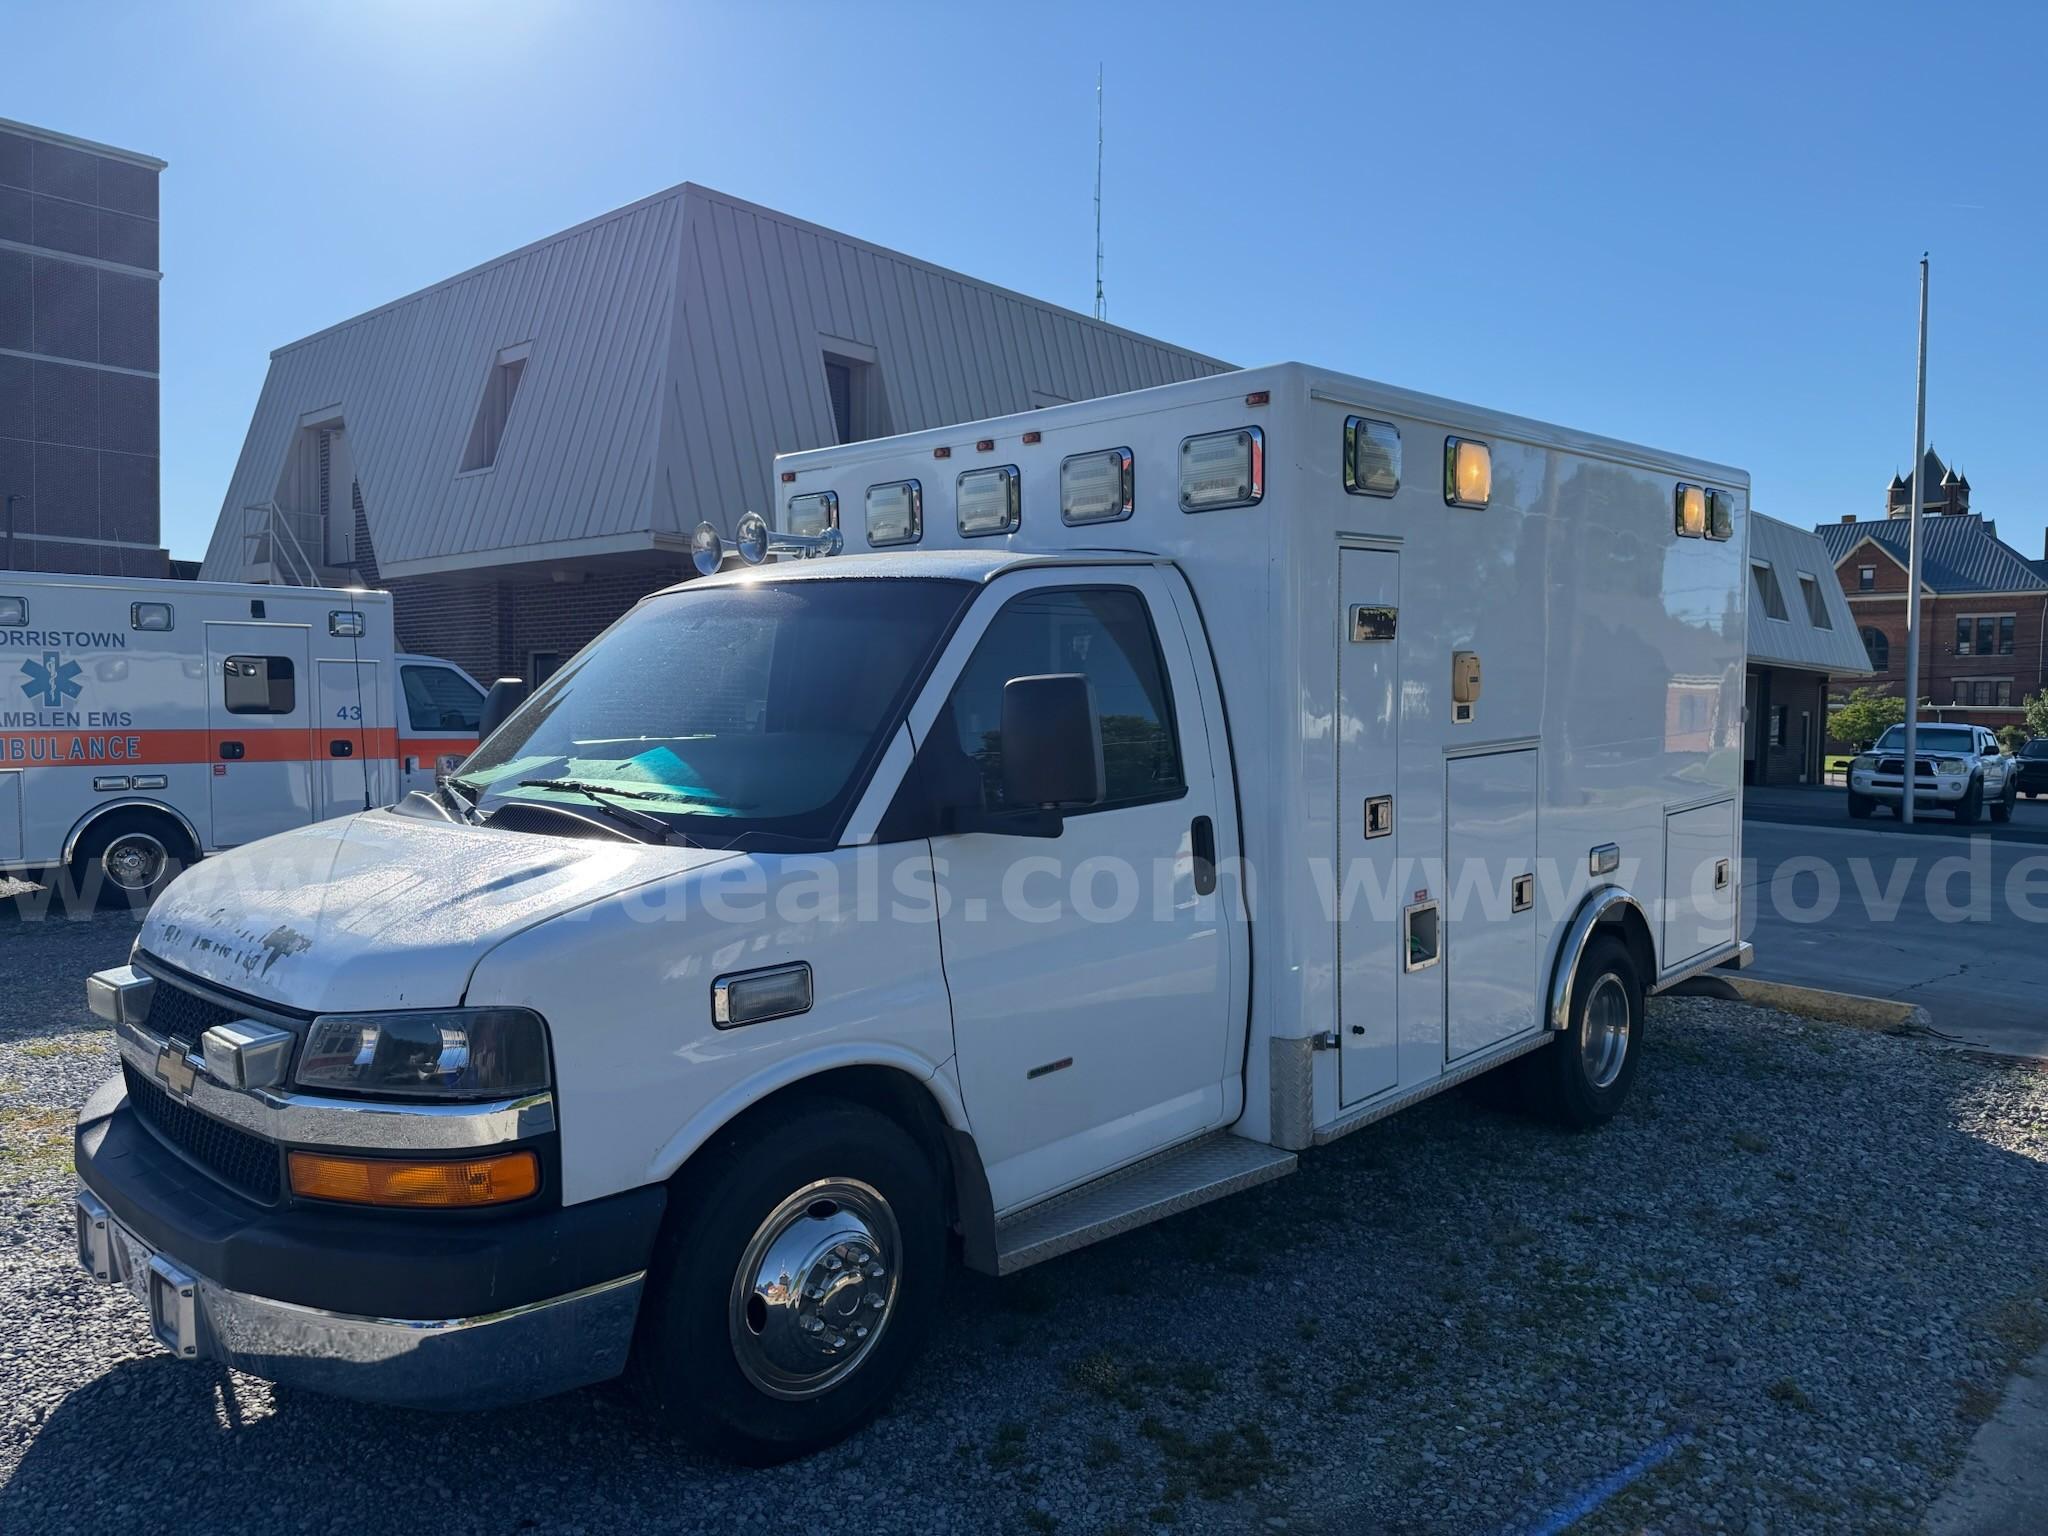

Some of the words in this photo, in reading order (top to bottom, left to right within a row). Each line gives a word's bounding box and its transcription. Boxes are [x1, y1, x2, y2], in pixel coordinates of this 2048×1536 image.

[0, 711, 80, 728] MBLEN
[87, 711, 132, 727] EMS
[336, 705, 361, 721] 43
